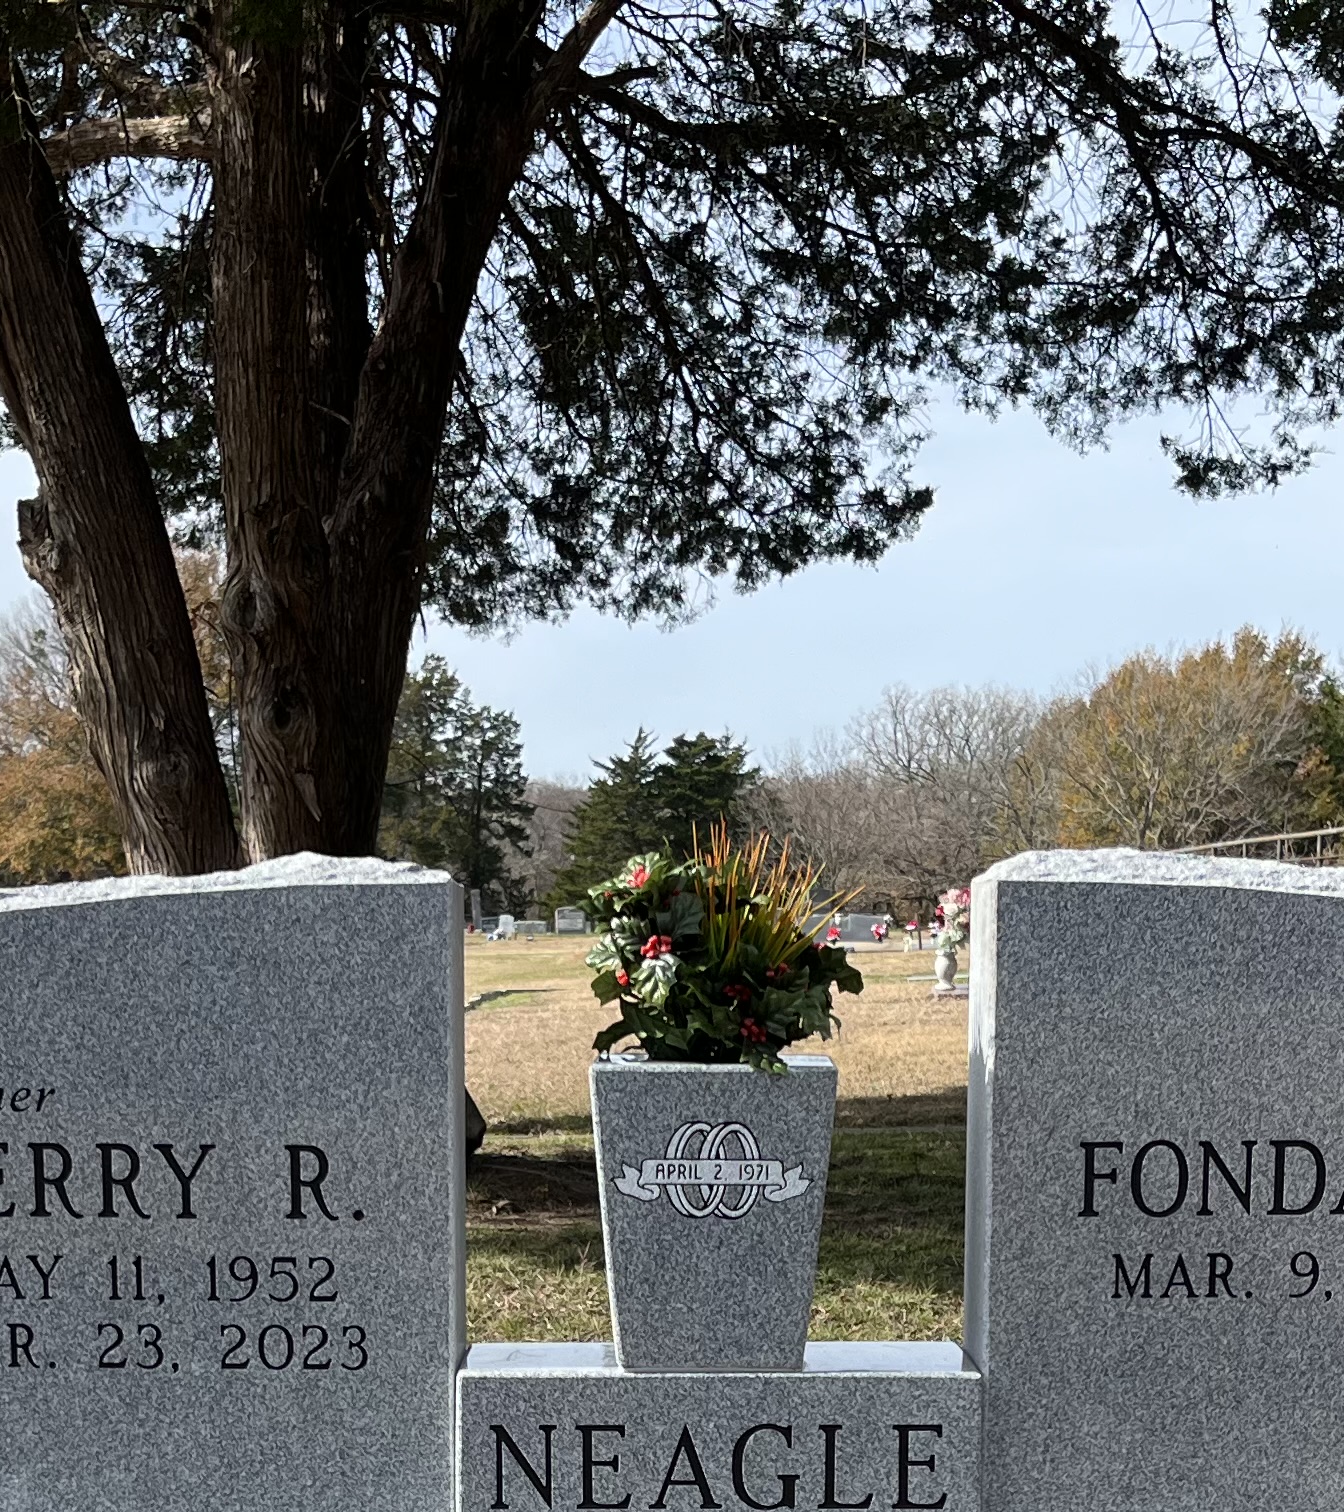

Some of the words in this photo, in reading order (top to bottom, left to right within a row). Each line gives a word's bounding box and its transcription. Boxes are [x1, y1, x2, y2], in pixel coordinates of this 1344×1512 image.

[283, 1143, 366, 1222] R.
[655, 1163, 702, 1181] APRIL
[737, 1163, 770, 1181] 1971
[107, 1255, 166, 1305] 11,
[205, 1255, 339, 1303] 1952
[1111, 1252, 1253, 1300] MAR.
[1288, 1251, 1333, 1301] 9,
[96, 1322, 180, 1373] 23,
[219, 1323, 369, 1371] 2023
[488, 1422, 948, 1511] NEAGLE
